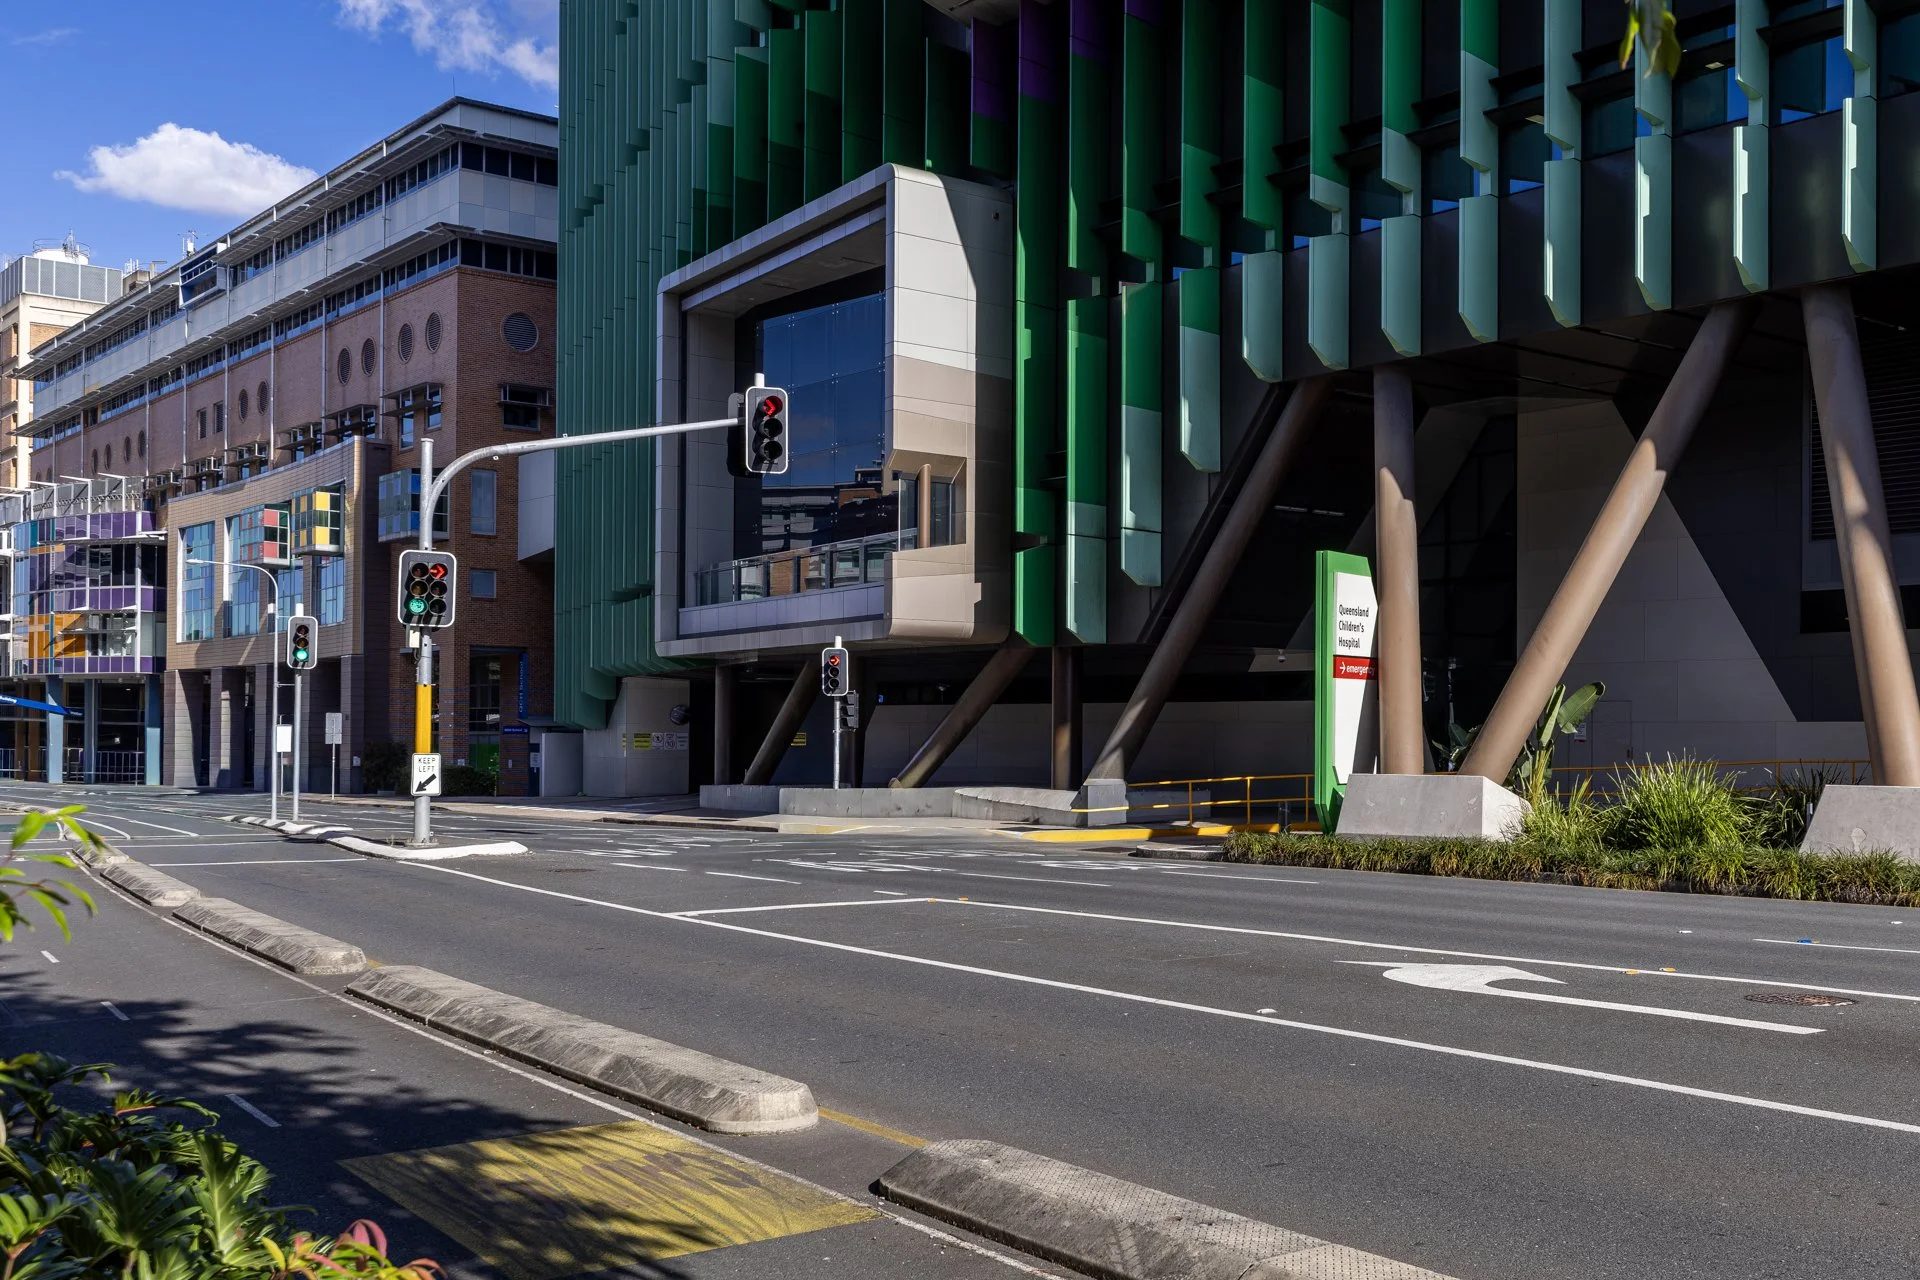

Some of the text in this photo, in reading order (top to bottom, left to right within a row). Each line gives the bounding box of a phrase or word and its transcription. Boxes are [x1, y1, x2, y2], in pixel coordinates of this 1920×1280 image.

[1339, 604, 1369, 617] Queensland
[1338, 620, 1364, 633] Children's
[1338, 636, 1360, 650] Hospital
[1346, 665, 1375, 676] emergency
